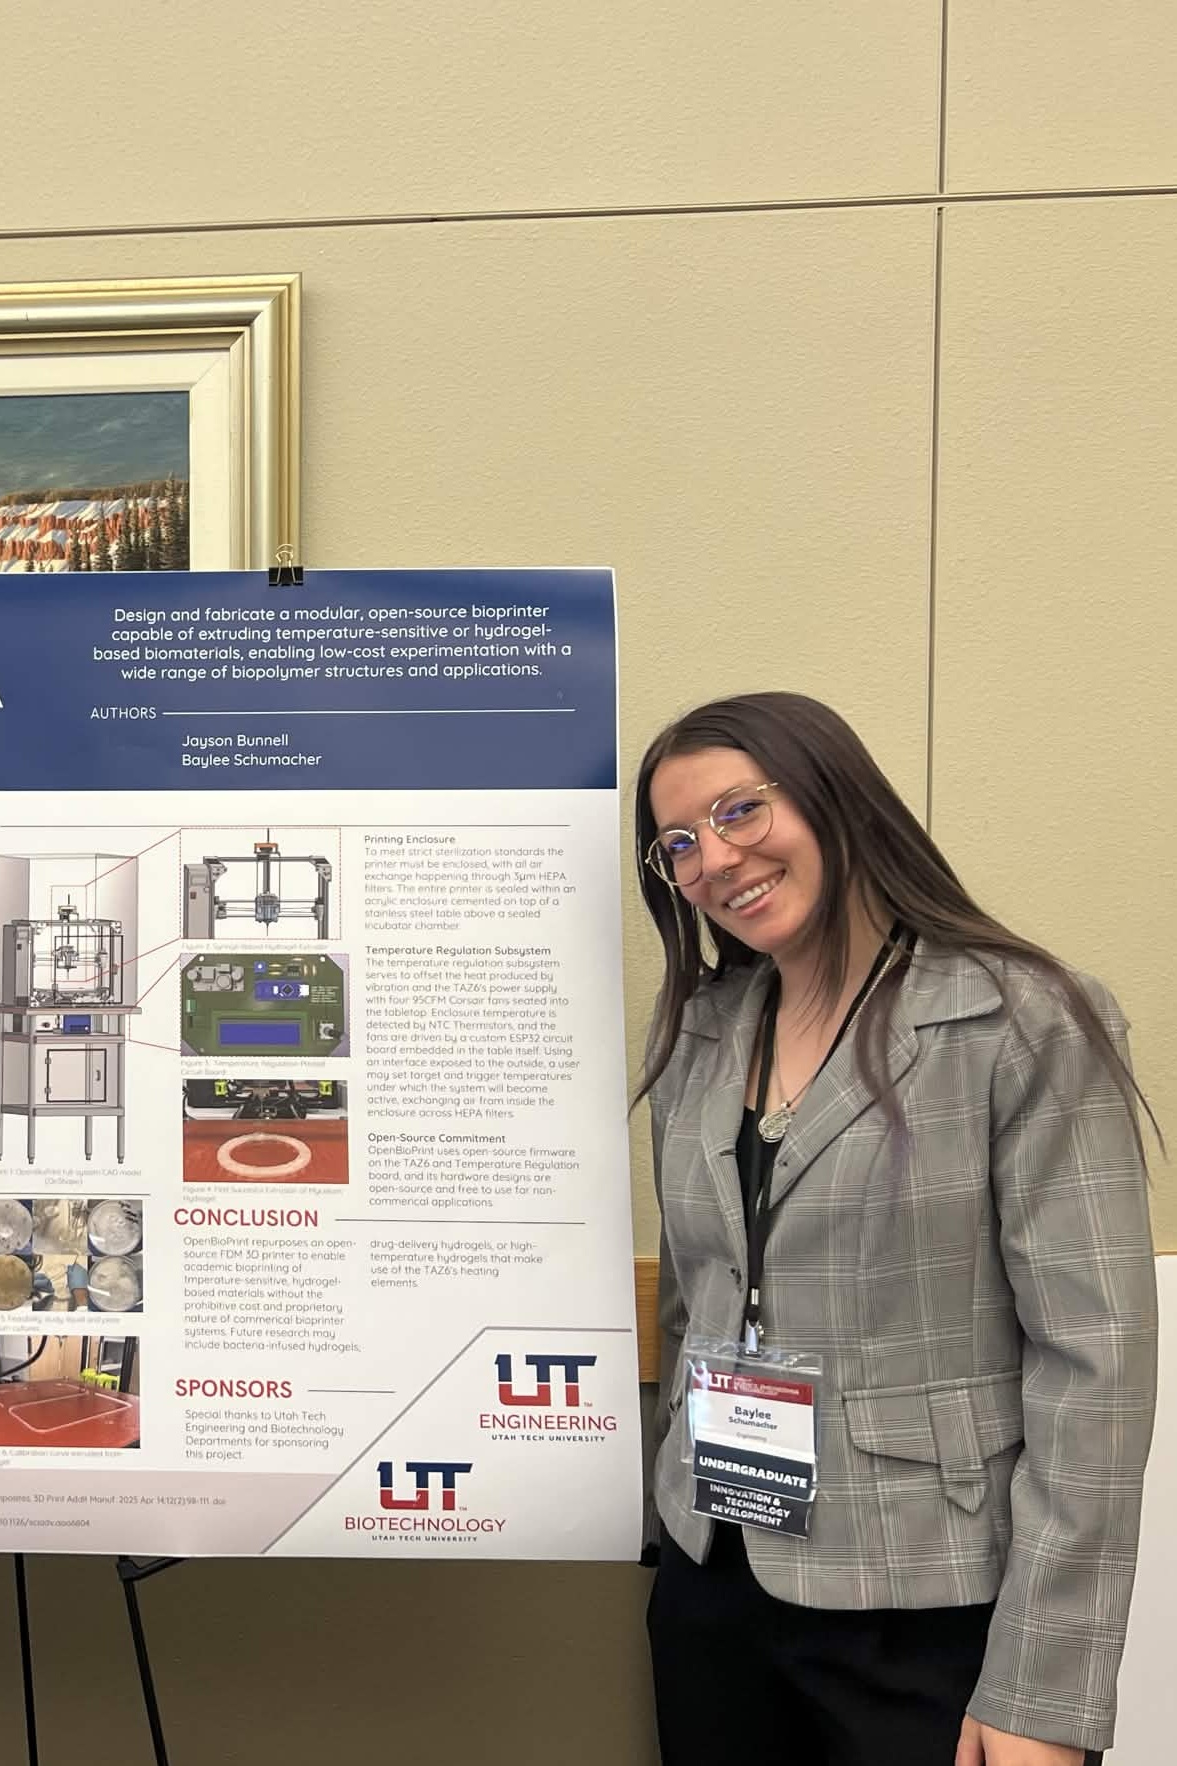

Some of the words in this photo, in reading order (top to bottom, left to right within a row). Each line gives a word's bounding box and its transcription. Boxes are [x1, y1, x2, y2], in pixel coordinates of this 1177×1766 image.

[114, 608, 165, 624] Design
[170, 607, 199, 621] and
[204, 607, 275, 621] fabricate
[279, 610, 289, 620] a
[294, 605, 363, 622] modular,
[368, 607, 468, 622] open-source
[472, 604, 549, 620] bioprinter
[111, 627, 173, 643] capable
[177, 626, 194, 640] of
[198, 626, 270, 643] extruding
[275, 624, 448, 642] temperature-sensitive
[452, 627, 469, 637] or
[474, 623, 551, 640] hydrogel-
[93, 646, 139, 661] based
[145, 645, 243, 662] biomaterials,
[248, 641, 314, 662] enabling
[320, 644, 385, 658] low-cost
[390, 643, 519, 660] experimentation
[524, 641, 556, 656] with
[561, 645, 571, 655] a
[121, 665, 156, 680] wide
[161, 668, 206, 682] range
[211, 664, 227, 678] of
[232, 664, 320, 681] biopolymer
[324, 665, 403, 677] structures
[408, 663, 437, 676] and
[443, 662, 542, 679] applications.
[90, 706, 156, 720] AUTHORS
[182, 735, 232, 749] Jayson
[237, 733, 288, 746] Bunnell
[182, 753, 229, 768] Baylee
[233, 752, 322, 766] Schumacher
[364, 833, 403, 845] Printing
[406, 834, 455, 843] Enclosure
[365, 944, 433, 956] Temperature
[436, 945, 491, 957] Regulation
[494, 945, 551, 957] Subsystem
[367, 1132, 435, 1144] Open-Source
[438, 1133, 505, 1143] Commitment
[174, 1208, 317, 1227] CONCLUSION
[175, 1378, 292, 1398] SPONSORS
[185, 1409, 221, 1421] Special
[224, 1409, 258, 1419] thanks
[260, 1410, 271, 1419] to
[274, 1410, 298, 1420] Utah
[301, 1410, 326, 1420] Tech
[734, 1406, 772, 1420] Baylee
[185, 1422, 245, 1435] Engineering
[247, 1423, 267, 1433] and
[270, 1423, 343, 1437] Biotechnology
[480, 1413, 616, 1431] ENGINEERING
[728, 1416, 778, 1430] Schumacher
[185, 1435, 252, 1448] Departments
[255, 1436, 268, 1446] for
[272, 1437, 328, 1450] sponsoring
[699, 1455, 808, 1488] UNDERGRADUATE
[709, 1483, 771, 1505] INNOVATION
[772, 1496, 781, 1506] &
[710, 1502, 782, 1527] DEVELOPMENT
[725, 1496, 791, 1518] TECHNOLOGY
[345, 1516, 505, 1533] BIOTECHNOLOGY
